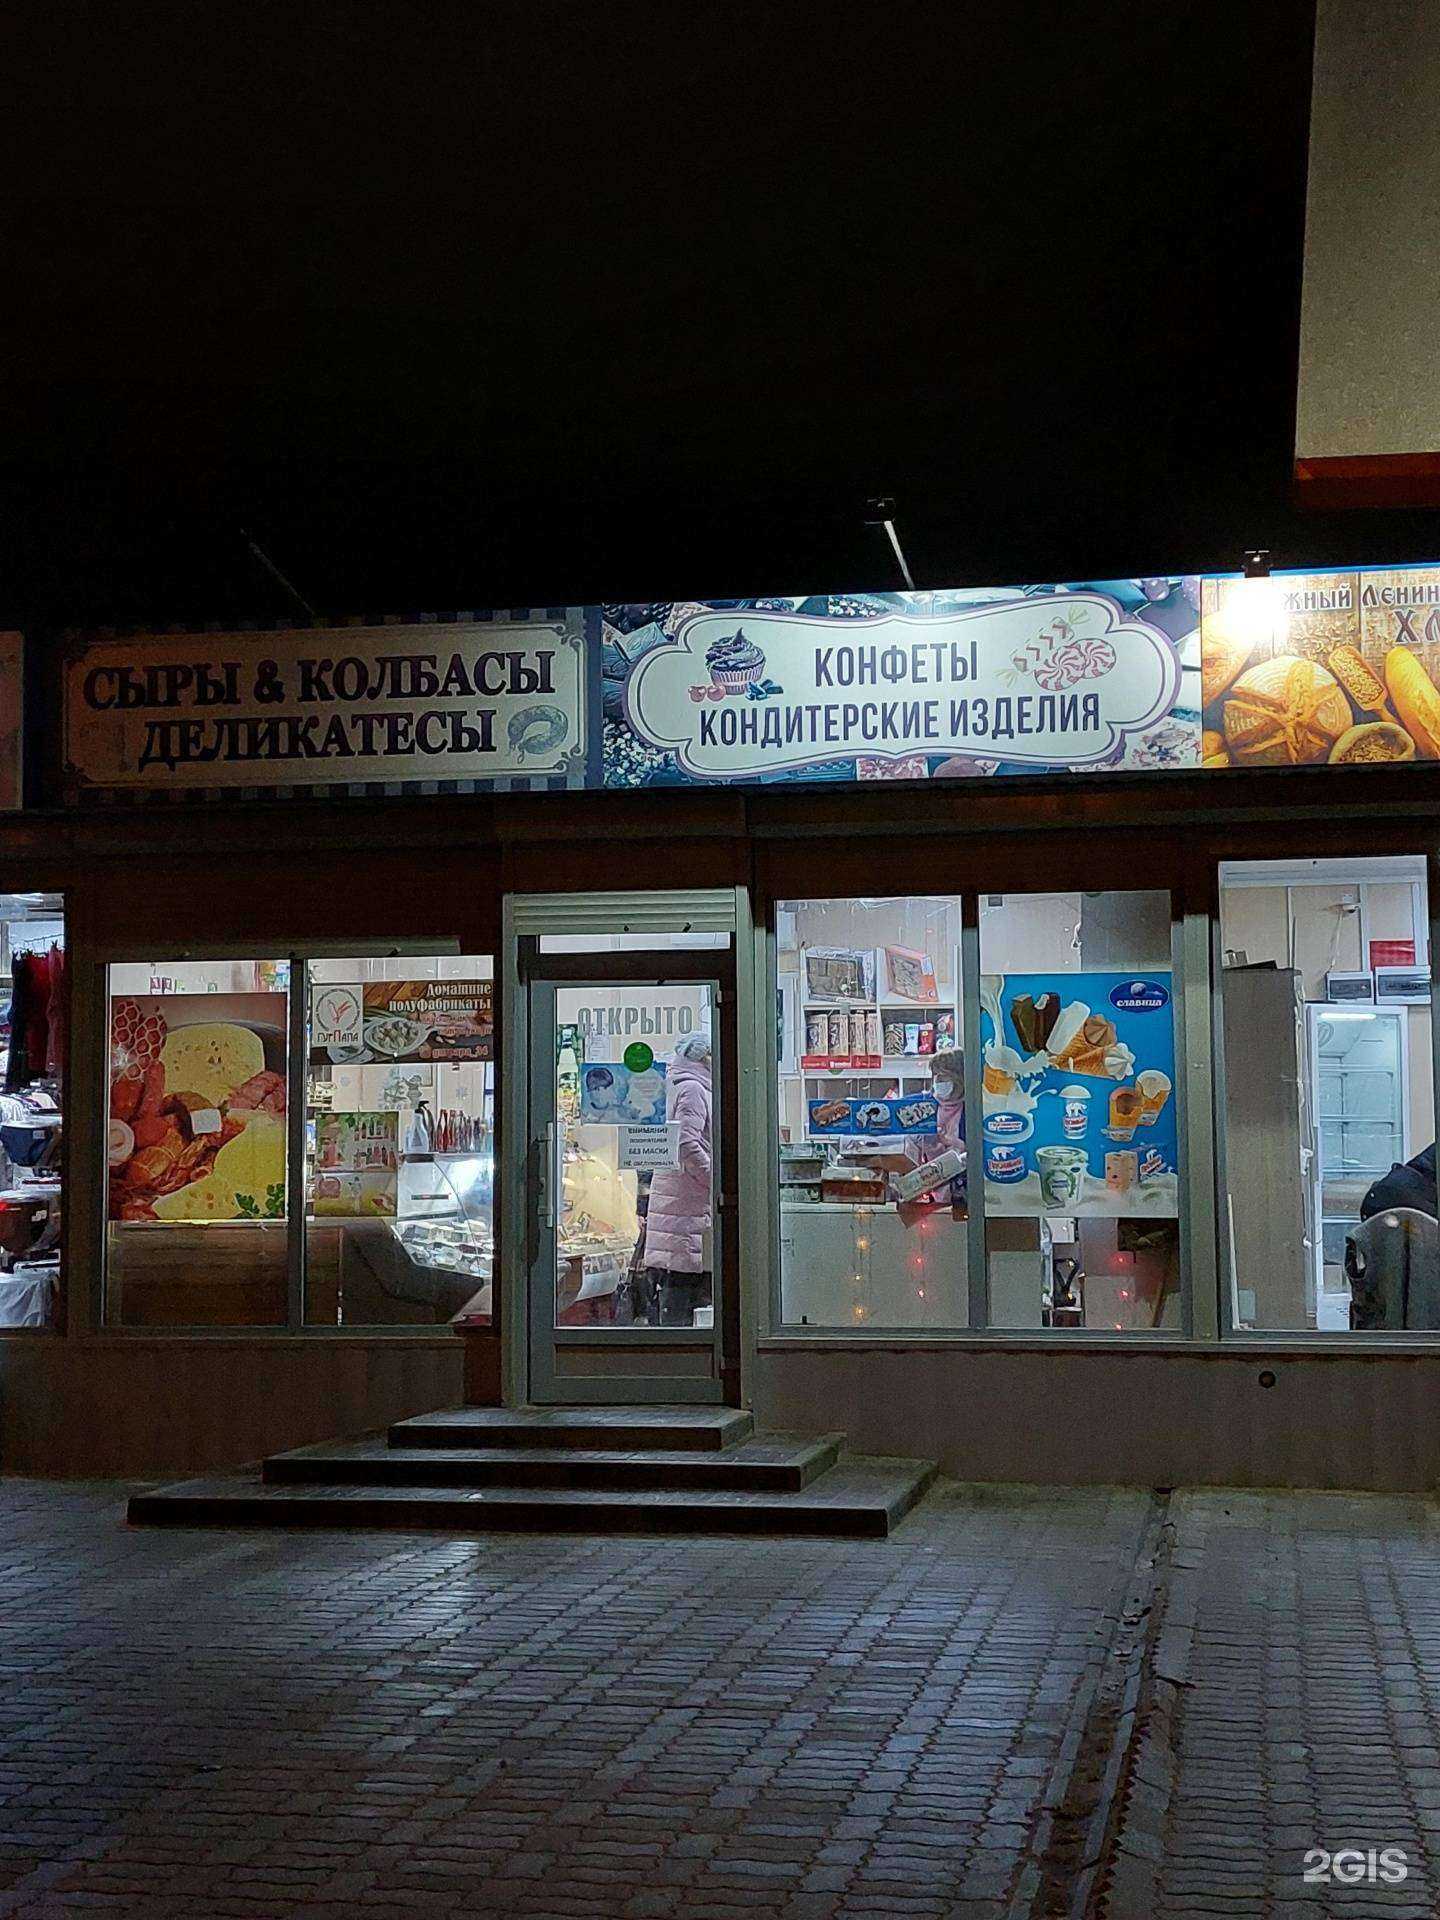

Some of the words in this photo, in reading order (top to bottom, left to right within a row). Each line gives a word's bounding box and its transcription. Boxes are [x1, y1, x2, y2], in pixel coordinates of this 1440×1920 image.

[83, 661, 241, 710] СЫРЫ
[253, 660, 285, 704] &
[296, 650, 555, 701] КОЛБАСЫ
[815, 641, 978, 687] КОНФЕТЫ
[138, 710, 498, 772] ДЕЛИКАТЕСЫ
[700, 700, 939, 747] КОНДИТЕРСКИЕ
[949, 693, 1100, 740] ИЗДЕЛИЯ
[388, 997, 492, 1013] полуфабрикаты
[427, 983, 492, 998] Домашние
[577, 1006, 693, 1036] ОТКРЫТО
